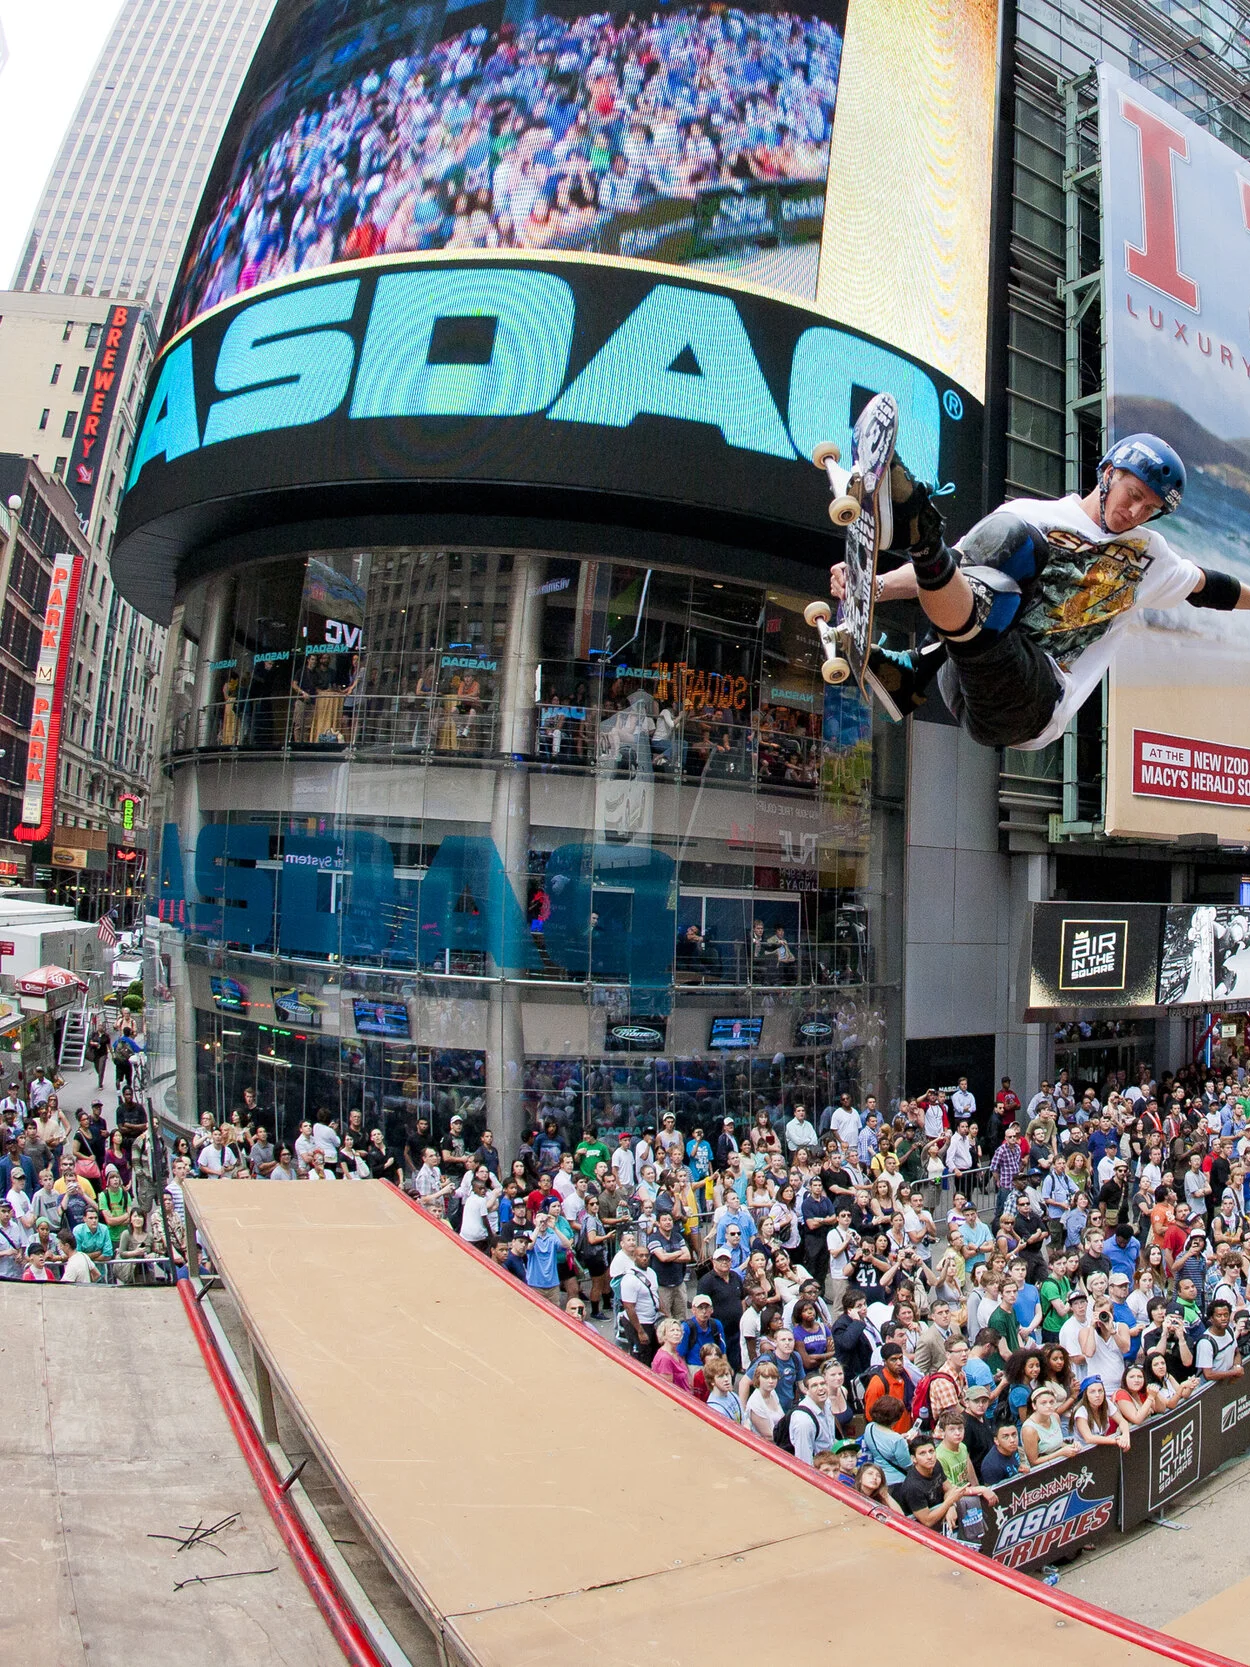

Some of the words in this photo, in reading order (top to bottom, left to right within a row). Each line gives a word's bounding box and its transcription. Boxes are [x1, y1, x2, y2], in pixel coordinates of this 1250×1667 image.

[81, 304, 129, 460] BREWERY
[42, 567, 68, 648] PARK
[27, 697, 49, 782] PARK
[1141, 765, 1189, 789] MACY'S
[1191, 772, 1235, 795] HERALD
[1149, 747, 1163, 758] AT
[1165, 750, 1184, 762] THE
[1193, 751, 1222, 772] NEW
[1223, 756, 1249, 776] IZOD
[1071, 958, 1086, 971] IN
[1087, 952, 1115, 970] THE
[1071, 963, 1115, 980] SQUARE
[855, 1269, 878, 1287] 47
[1238, 1394, 1247, 1405] THE
[1158, 1455, 1193, 1494] SQUARE
[1159, 1464, 1170, 1484] IN
[1173, 1441, 1193, 1470] THE
[992, 1501, 1114, 1570] TRIPLES
[997, 1495, 1070, 1552] ASA
